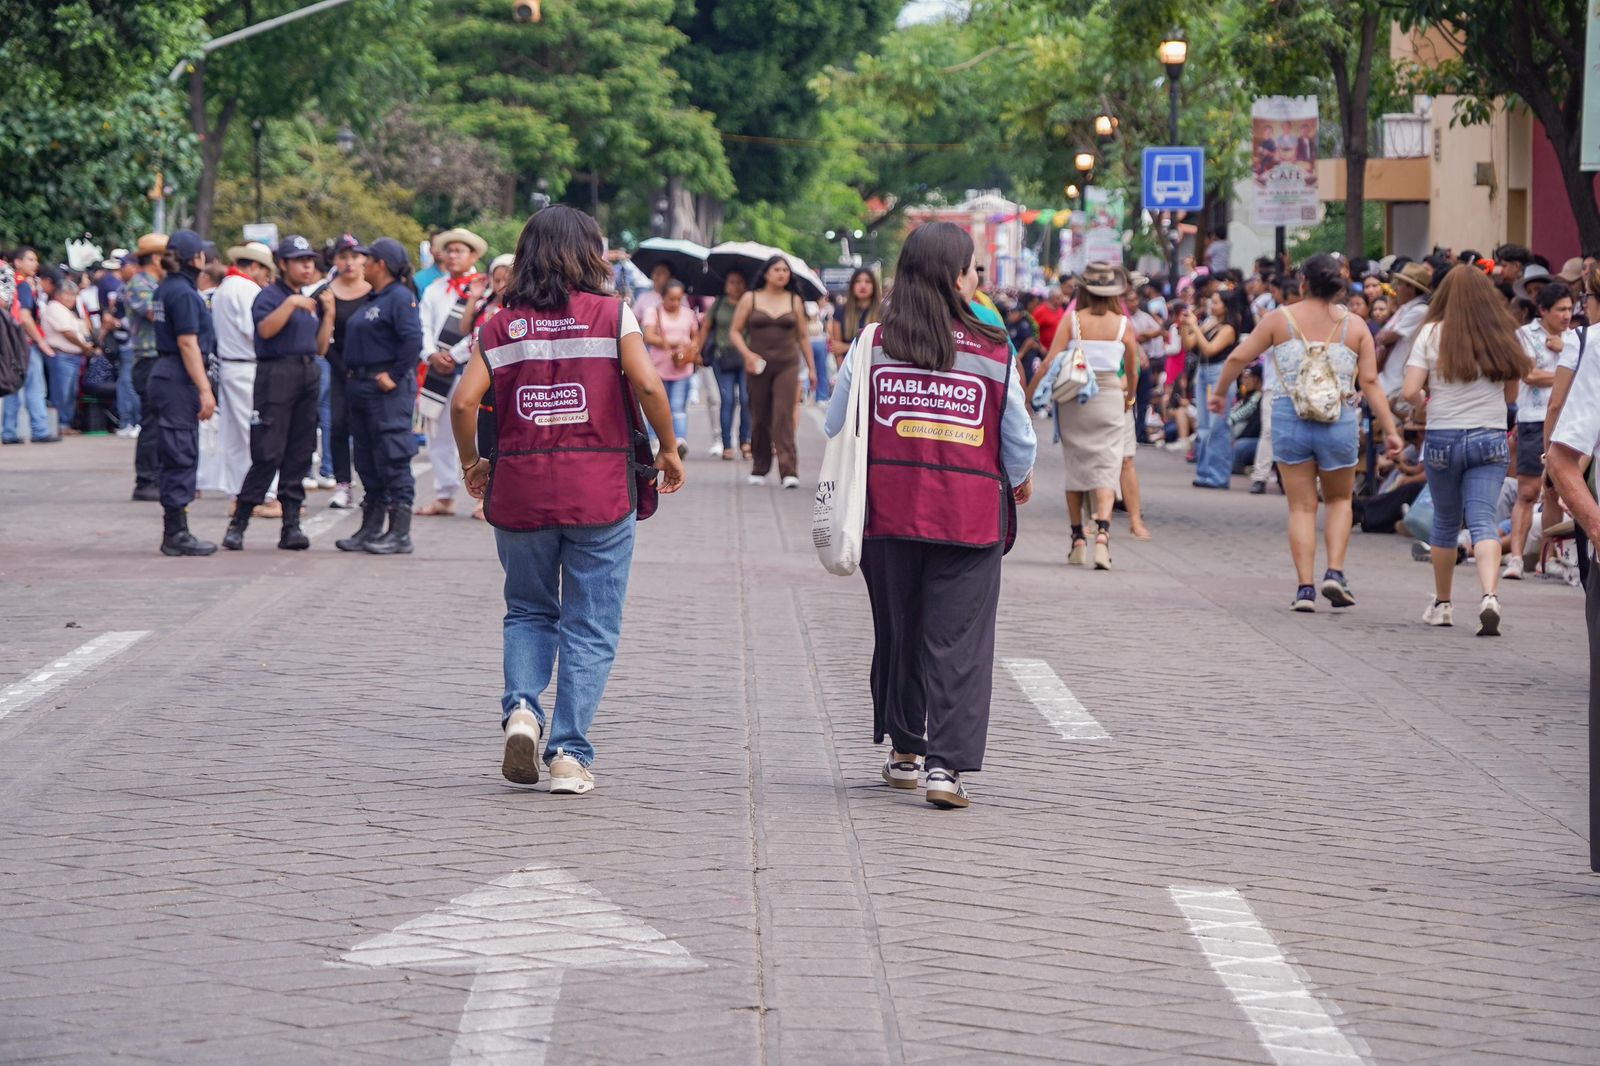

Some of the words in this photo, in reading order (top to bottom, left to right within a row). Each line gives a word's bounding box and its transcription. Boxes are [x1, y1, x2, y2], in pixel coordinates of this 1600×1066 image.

[535, 317, 575, 327] GOBIERNO
[523, 389, 578, 401] HABLAMOS
[880, 378, 977, 402] HABLAMOS
[534, 399, 579, 408] BLOQUEAMOS
[880, 395, 897, 405] NO
[899, 396, 975, 414] BLOQUEAMOS
[902, 425, 909, 433] EL
[911, 424, 943, 436] DIÁLOGO
[944, 428, 953, 437] ES
[954, 429, 964, 438] LA
[965, 432, 979, 442] PAZ
